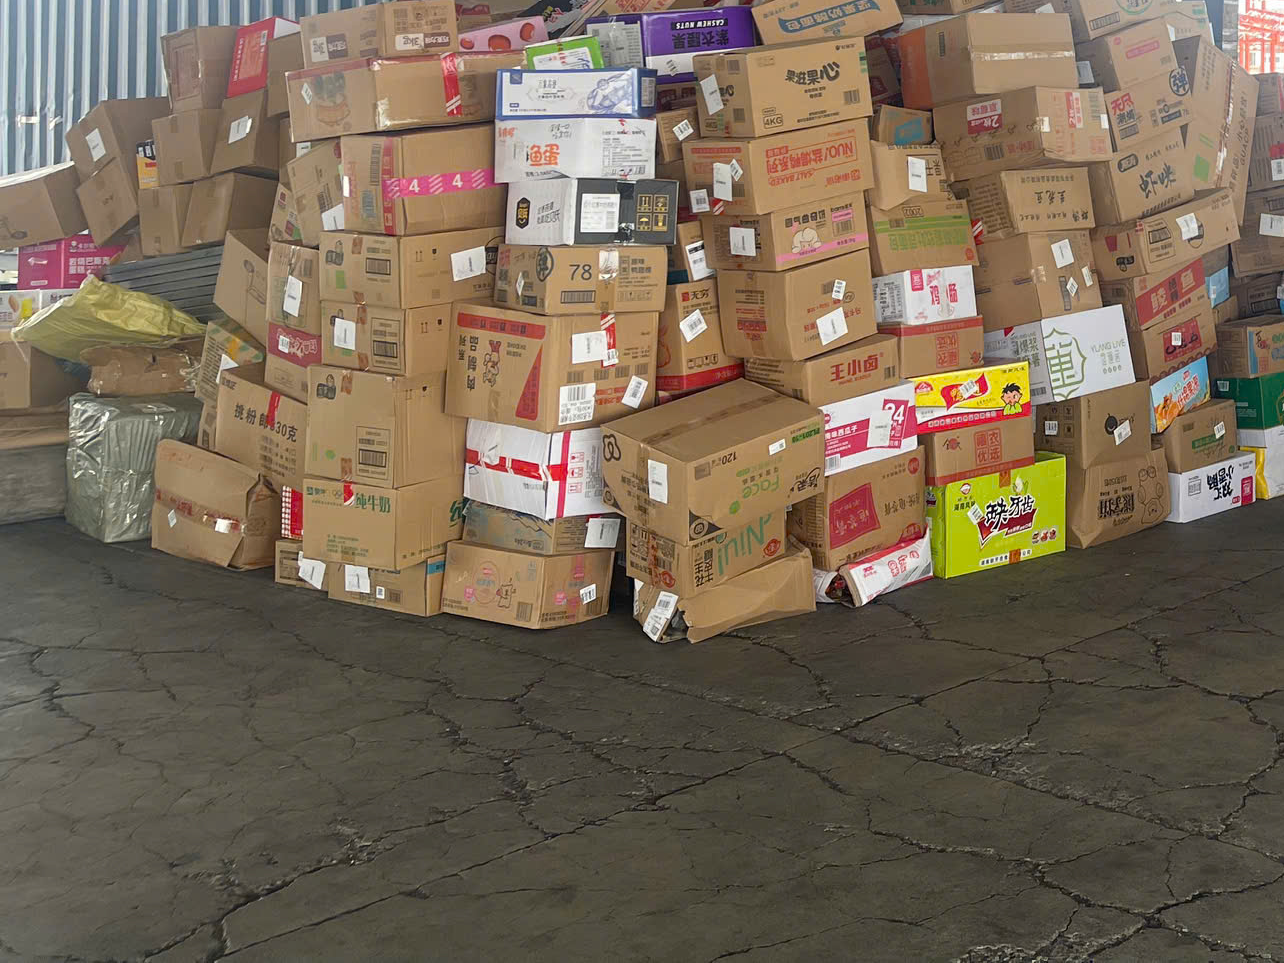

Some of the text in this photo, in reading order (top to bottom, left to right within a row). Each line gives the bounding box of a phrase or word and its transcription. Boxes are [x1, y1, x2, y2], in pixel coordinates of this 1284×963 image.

[675, 19, 725, 29] CASHEW NUTS
[672, 29, 730, 50] 紫衣腰果
[764, 116, 783, 126] 4KG
[409, 179, 421, 193] 4
[452, 174, 464, 187] 4
[904, 207, 923, 217] 2002
[569, 264, 592, 281] 78
[829, 354, 879, 382] 王小卤
[721, 451, 737, 465] 120
[742, 474, 780, 499] Face
[1206, 465, 1235, 491] 小香肠
[1212, 480, 1234, 502] 双汇
[354, 492, 391, 514] 纯牛奶
[985, 493, 1035, 531] 缺牙齿
